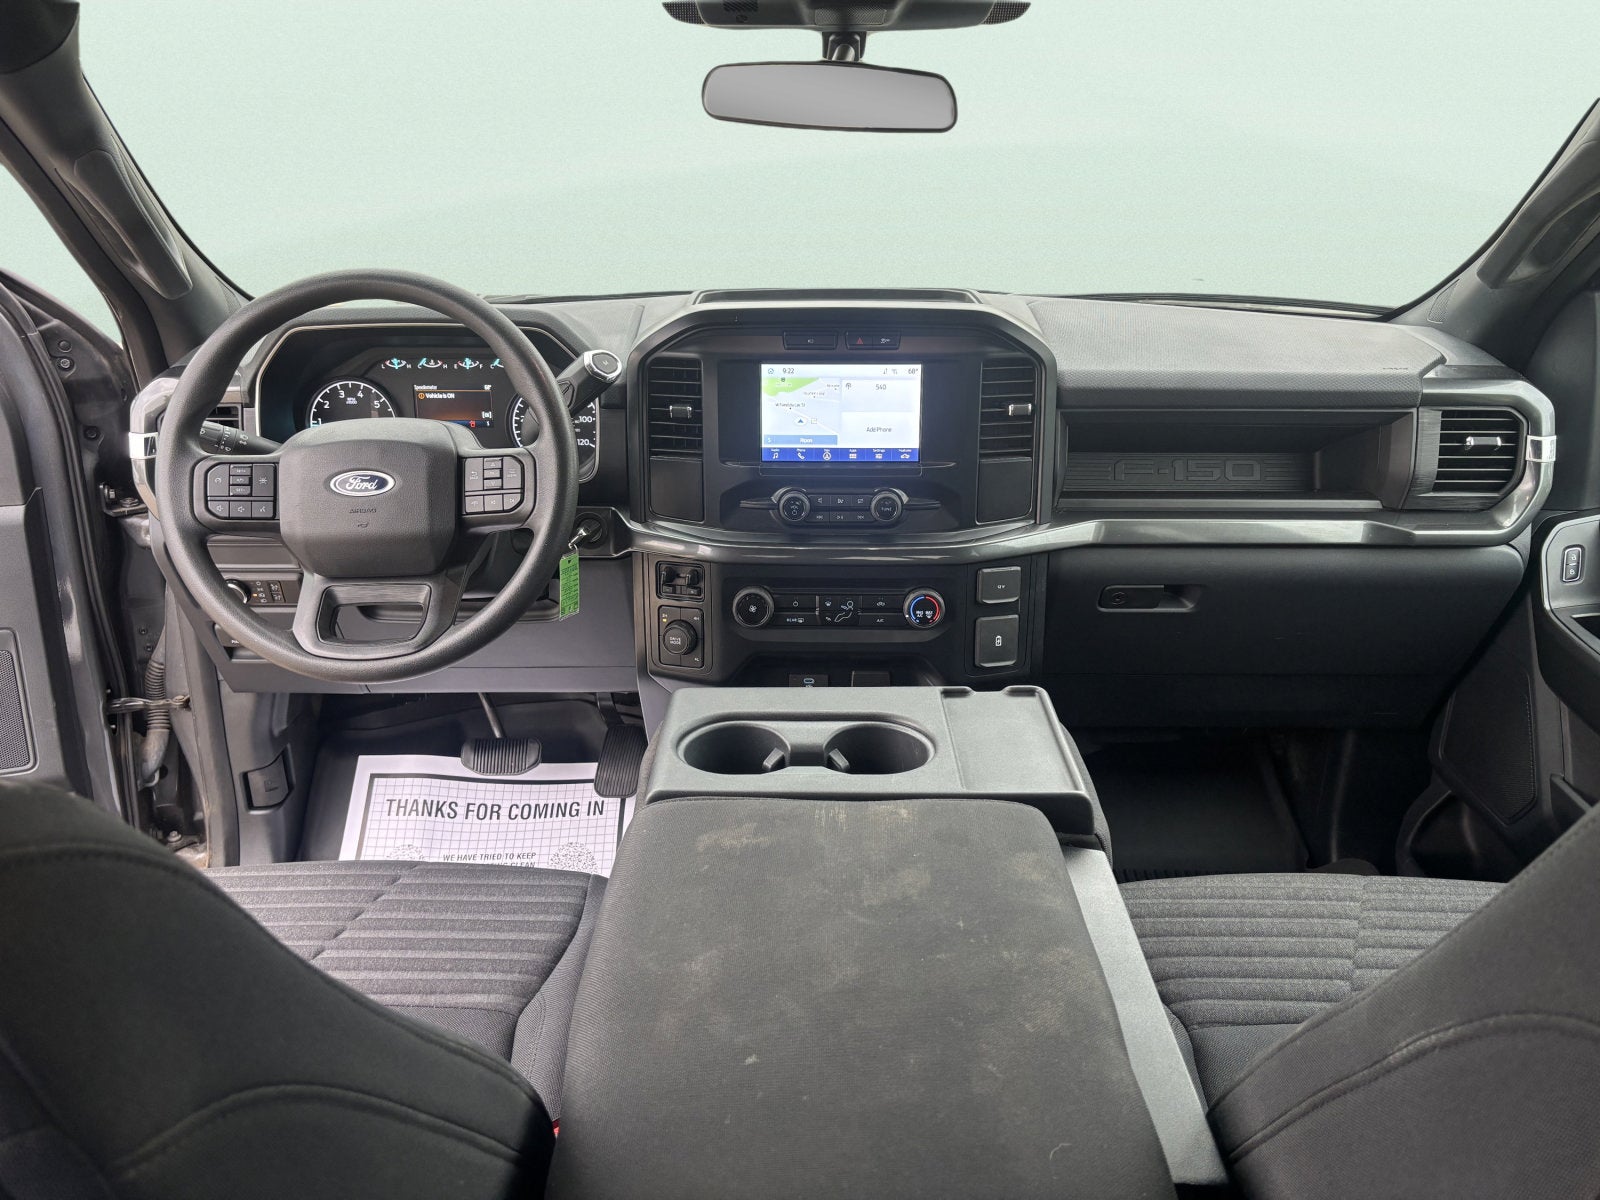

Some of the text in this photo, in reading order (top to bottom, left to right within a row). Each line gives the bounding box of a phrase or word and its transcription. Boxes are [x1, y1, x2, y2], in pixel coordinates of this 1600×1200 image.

[338, 390, 345, 399] 3
[357, 390, 364, 399] 4
[323, 400, 330, 409] 2
[373, 400, 381, 409] 5
[579, 415, 593, 423] 100
[576, 438, 590, 446] 120
[1113, 458, 1262, 482] F-150
[345, 475, 379, 491] Ford
[385, 798, 605, 821] THANKS FOR COMING IN
[457, 853, 477, 861] HAVE
[479, 853, 502, 861] TRIED
[504, 852, 514, 860] TO
[516, 852, 537, 860] KEEP
